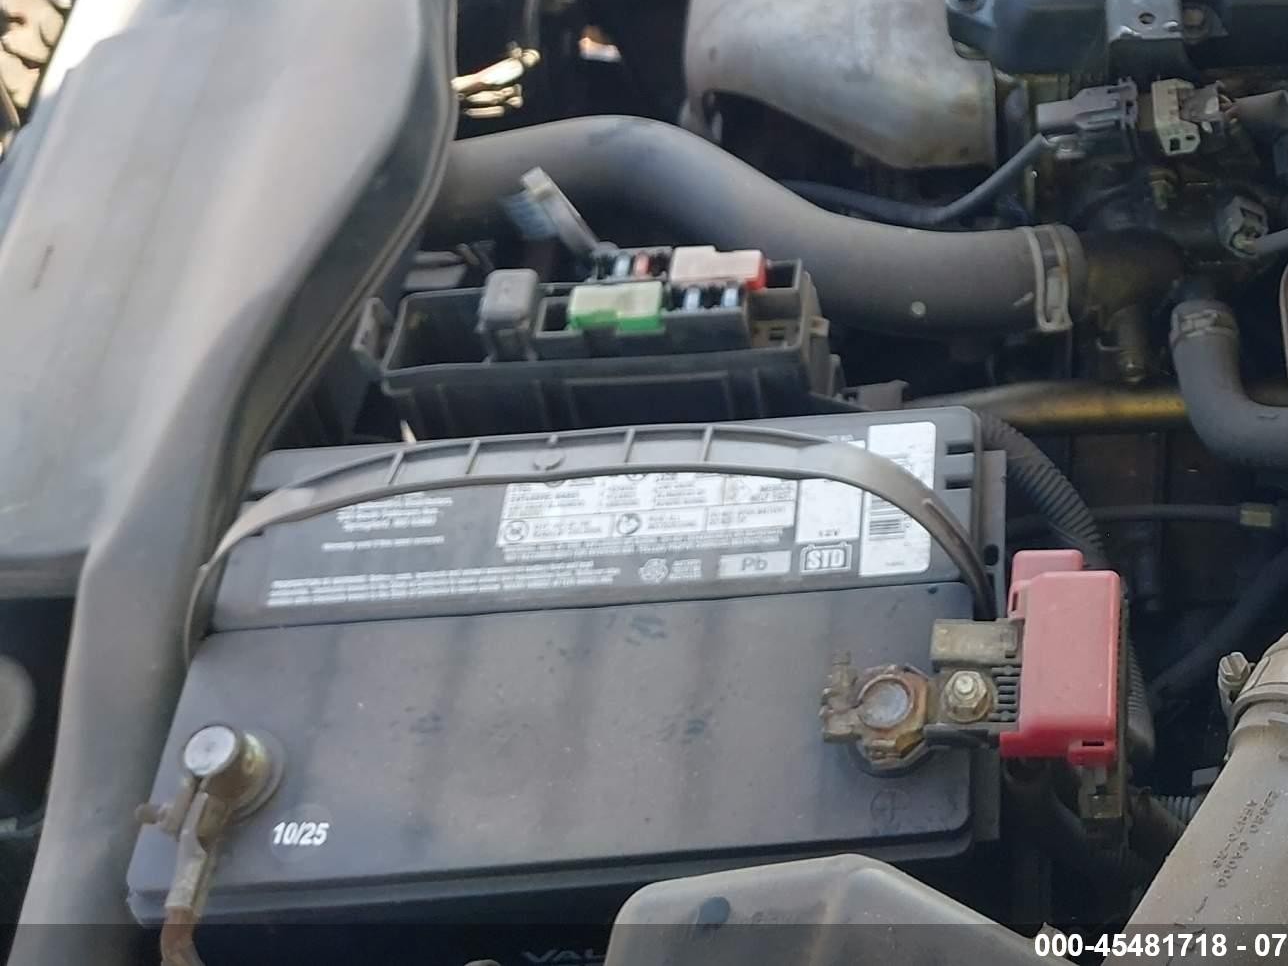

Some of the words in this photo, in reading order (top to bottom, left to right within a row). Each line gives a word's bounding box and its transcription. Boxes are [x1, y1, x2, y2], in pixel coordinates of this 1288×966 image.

[741, 555, 768, 571] Pb
[806, 548, 845, 569] STD
[272, 821, 330, 846] 10/25
